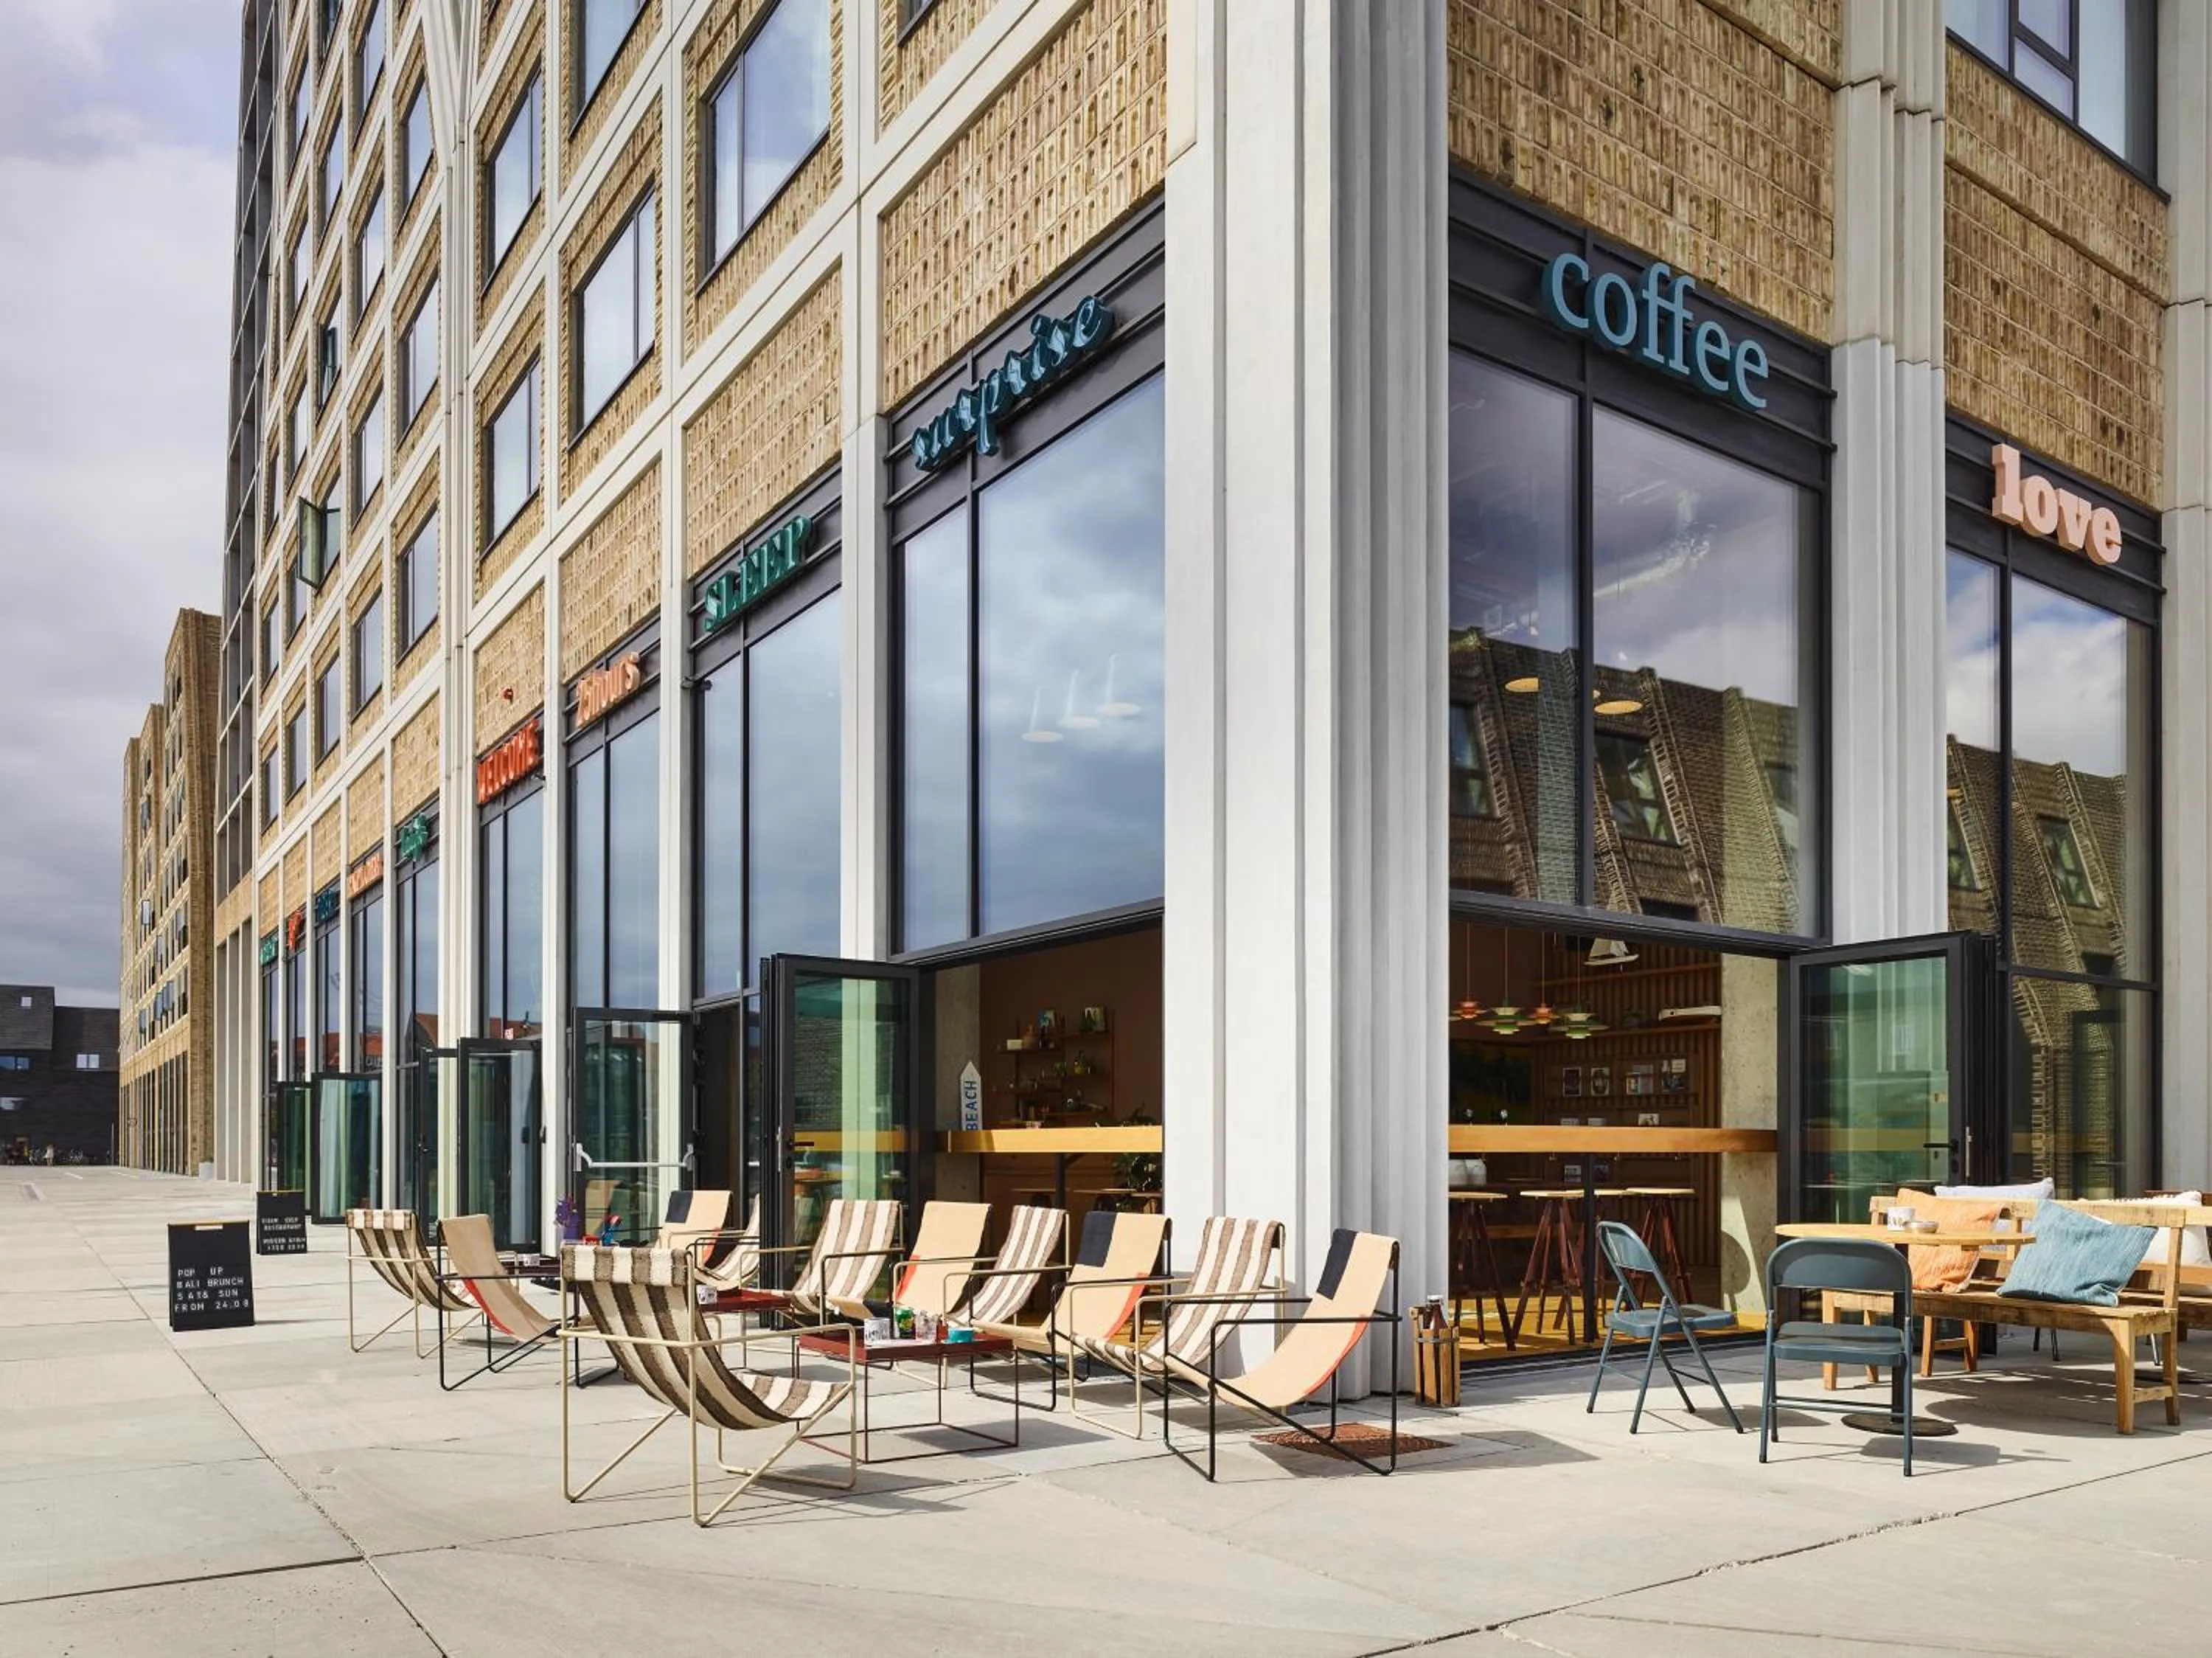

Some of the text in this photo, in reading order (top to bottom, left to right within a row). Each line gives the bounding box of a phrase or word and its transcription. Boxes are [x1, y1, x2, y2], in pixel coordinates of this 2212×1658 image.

[1544, 253, 1769, 410] coffee
[911, 295, 1114, 471] surprise
[1992, 443, 2122, 565] love
[705, 516, 812, 632] SLEEP
[964, 1081, 978, 1131] BEACH
[176, 1277, 244, 1288] BALI BRUNCH
[178, 1266, 223, 1277] POP UP
[218, 1288, 238, 1297] SUN
[174, 1303, 204, 1313] FROM
